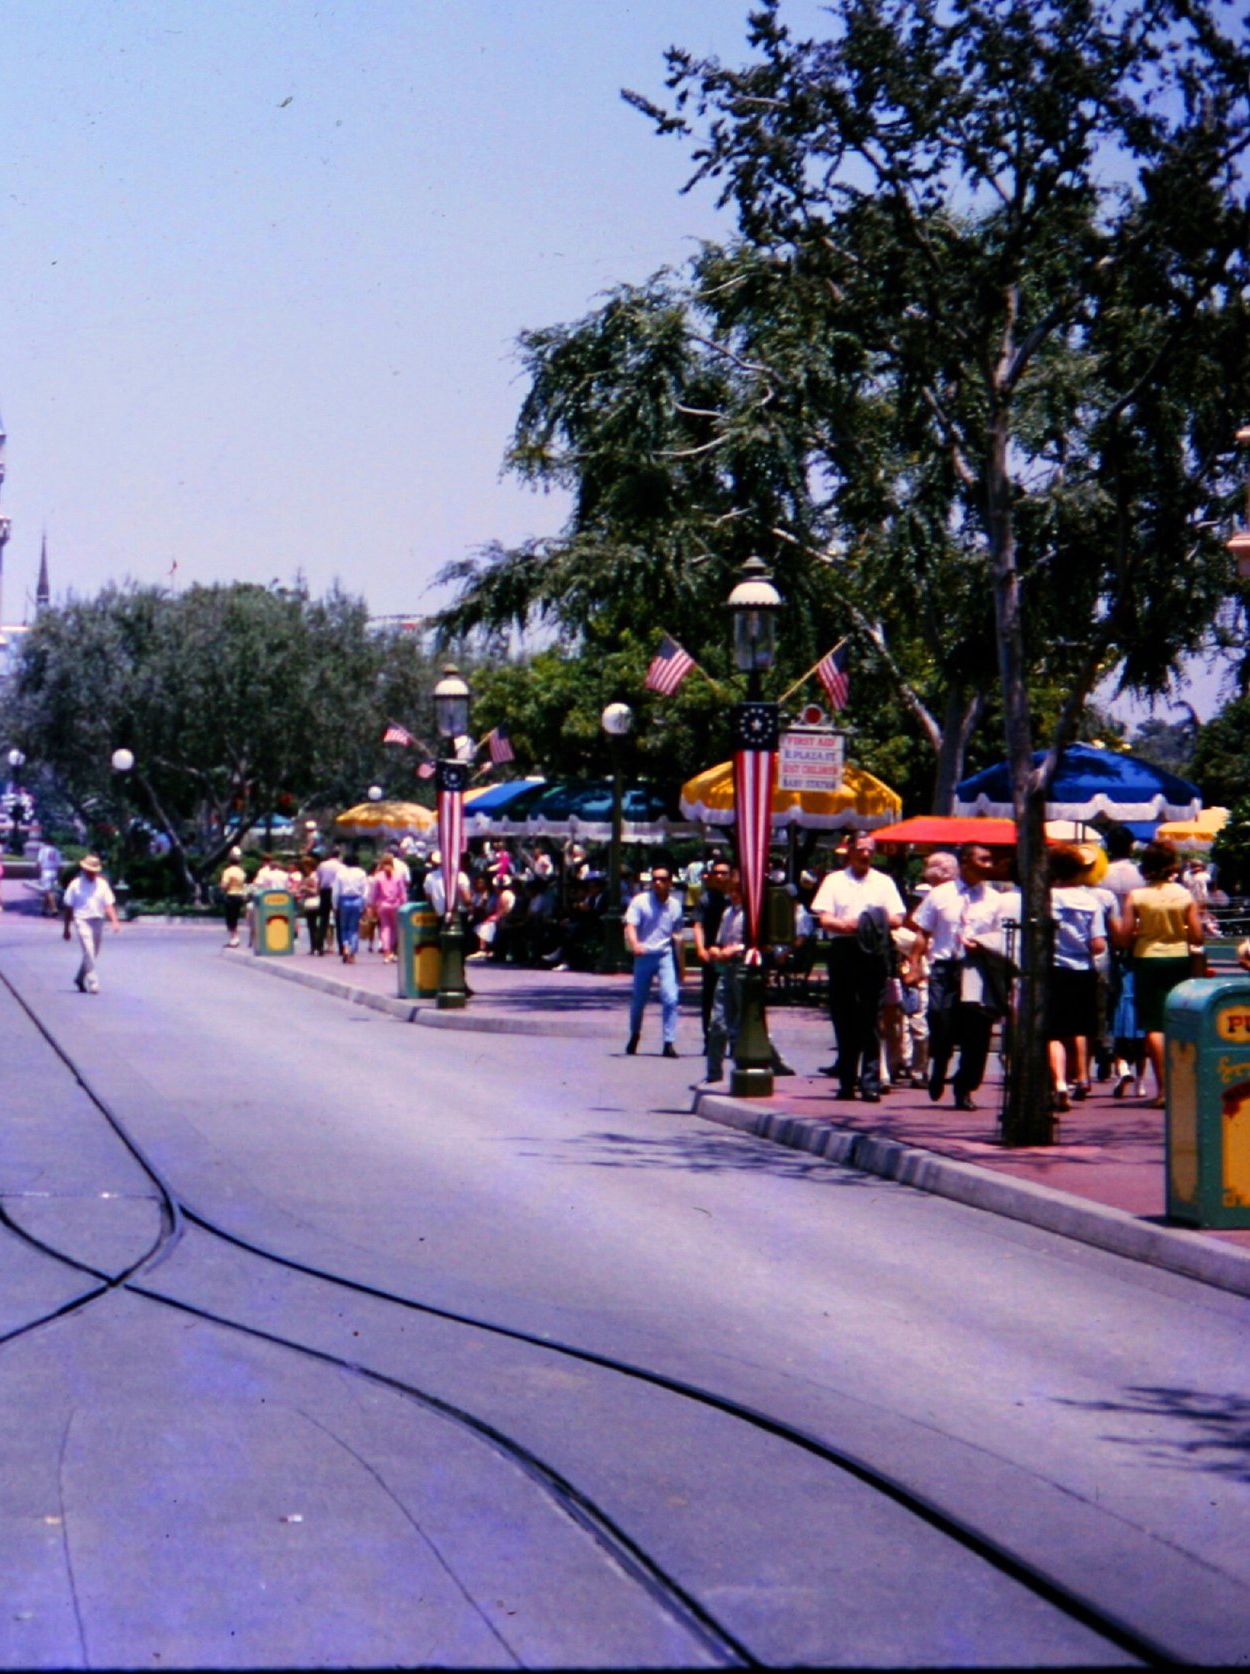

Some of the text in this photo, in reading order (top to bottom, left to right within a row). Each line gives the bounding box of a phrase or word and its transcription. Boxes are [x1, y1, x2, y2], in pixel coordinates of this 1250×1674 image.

[787, 736, 836, 748] FIRST AID
[793, 750, 823, 760] PLAZA
[805, 780, 836, 789] STATION
